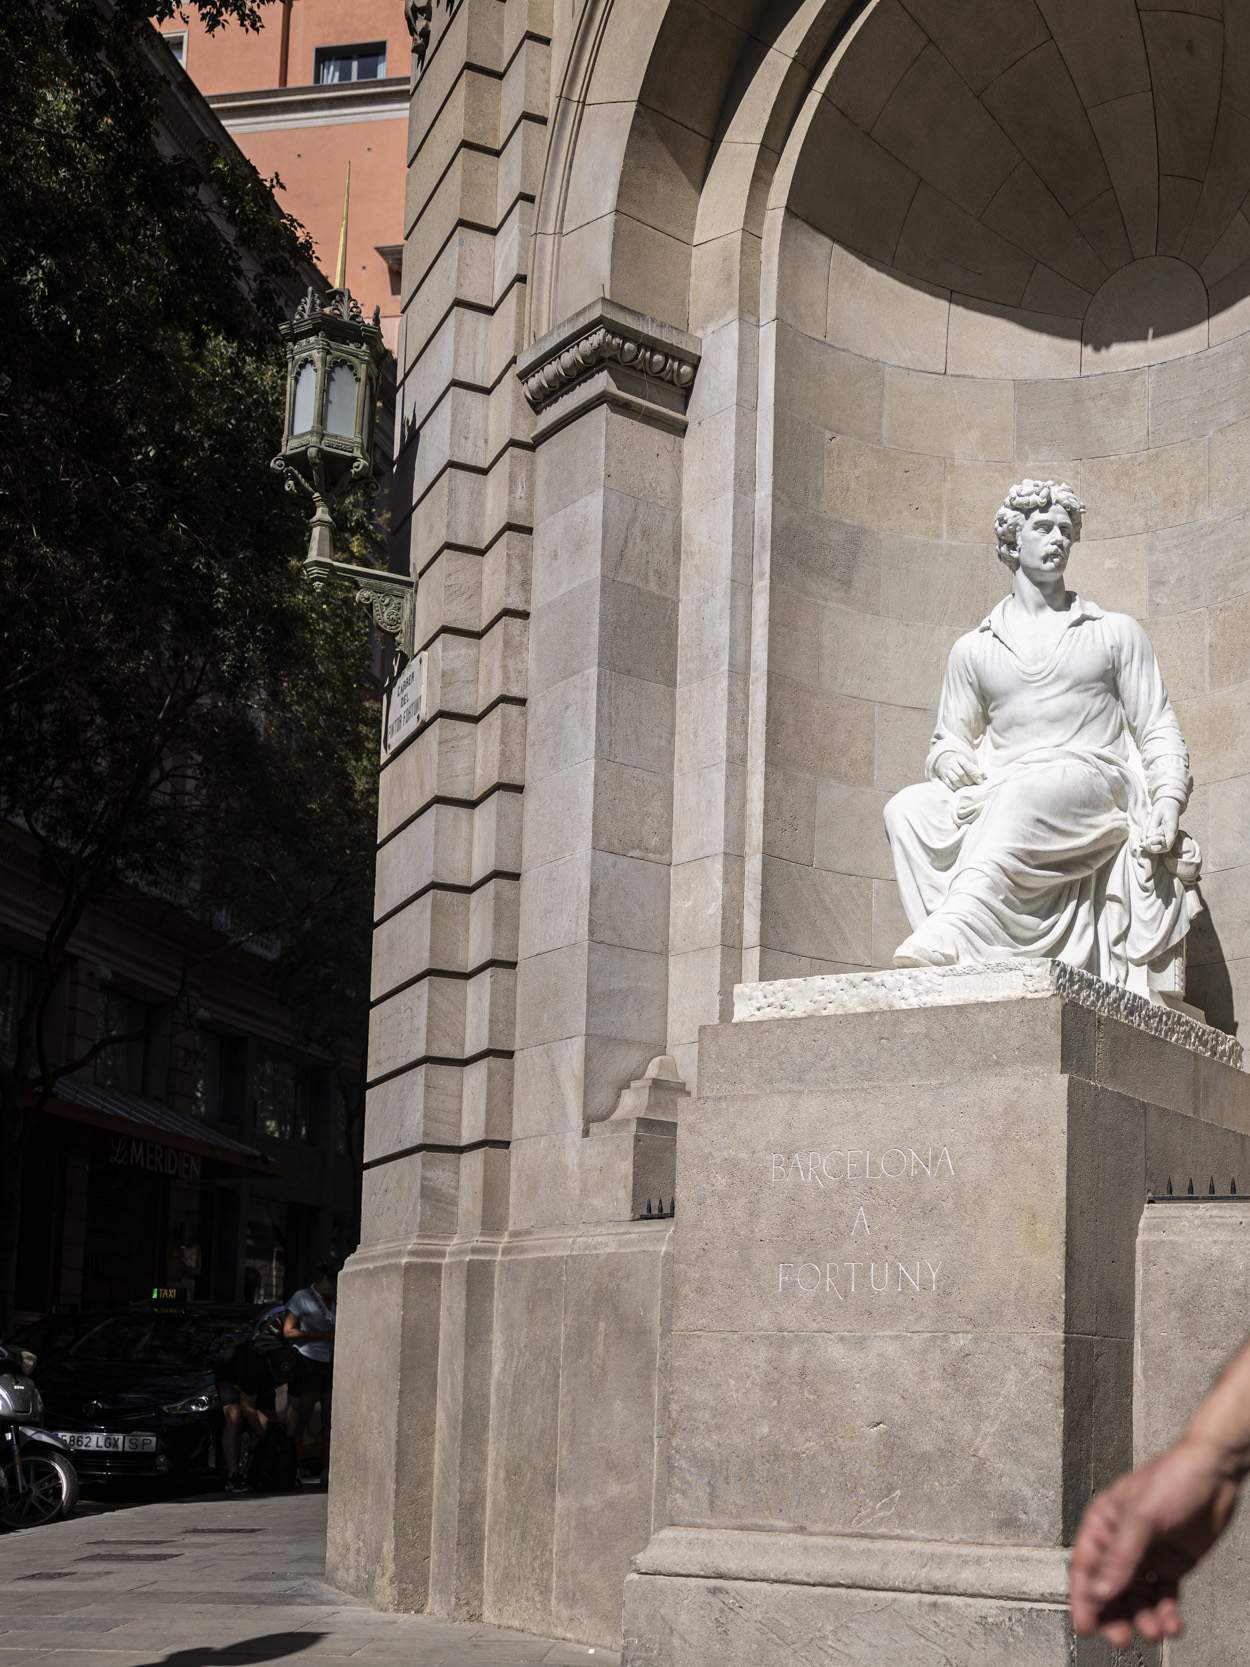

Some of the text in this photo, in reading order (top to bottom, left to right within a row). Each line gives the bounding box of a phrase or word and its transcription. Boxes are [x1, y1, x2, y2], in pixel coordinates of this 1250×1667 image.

[129, 1139, 201, 1180] MERIDIEN
[770, 1146, 956, 1188] BARCELONA
[851, 1205, 871, 1236] A
[158, 1287, 177, 1300] TAXI
[777, 1261, 942, 1300] FORTUNY
[95, 1436, 120, 1449] LGX
